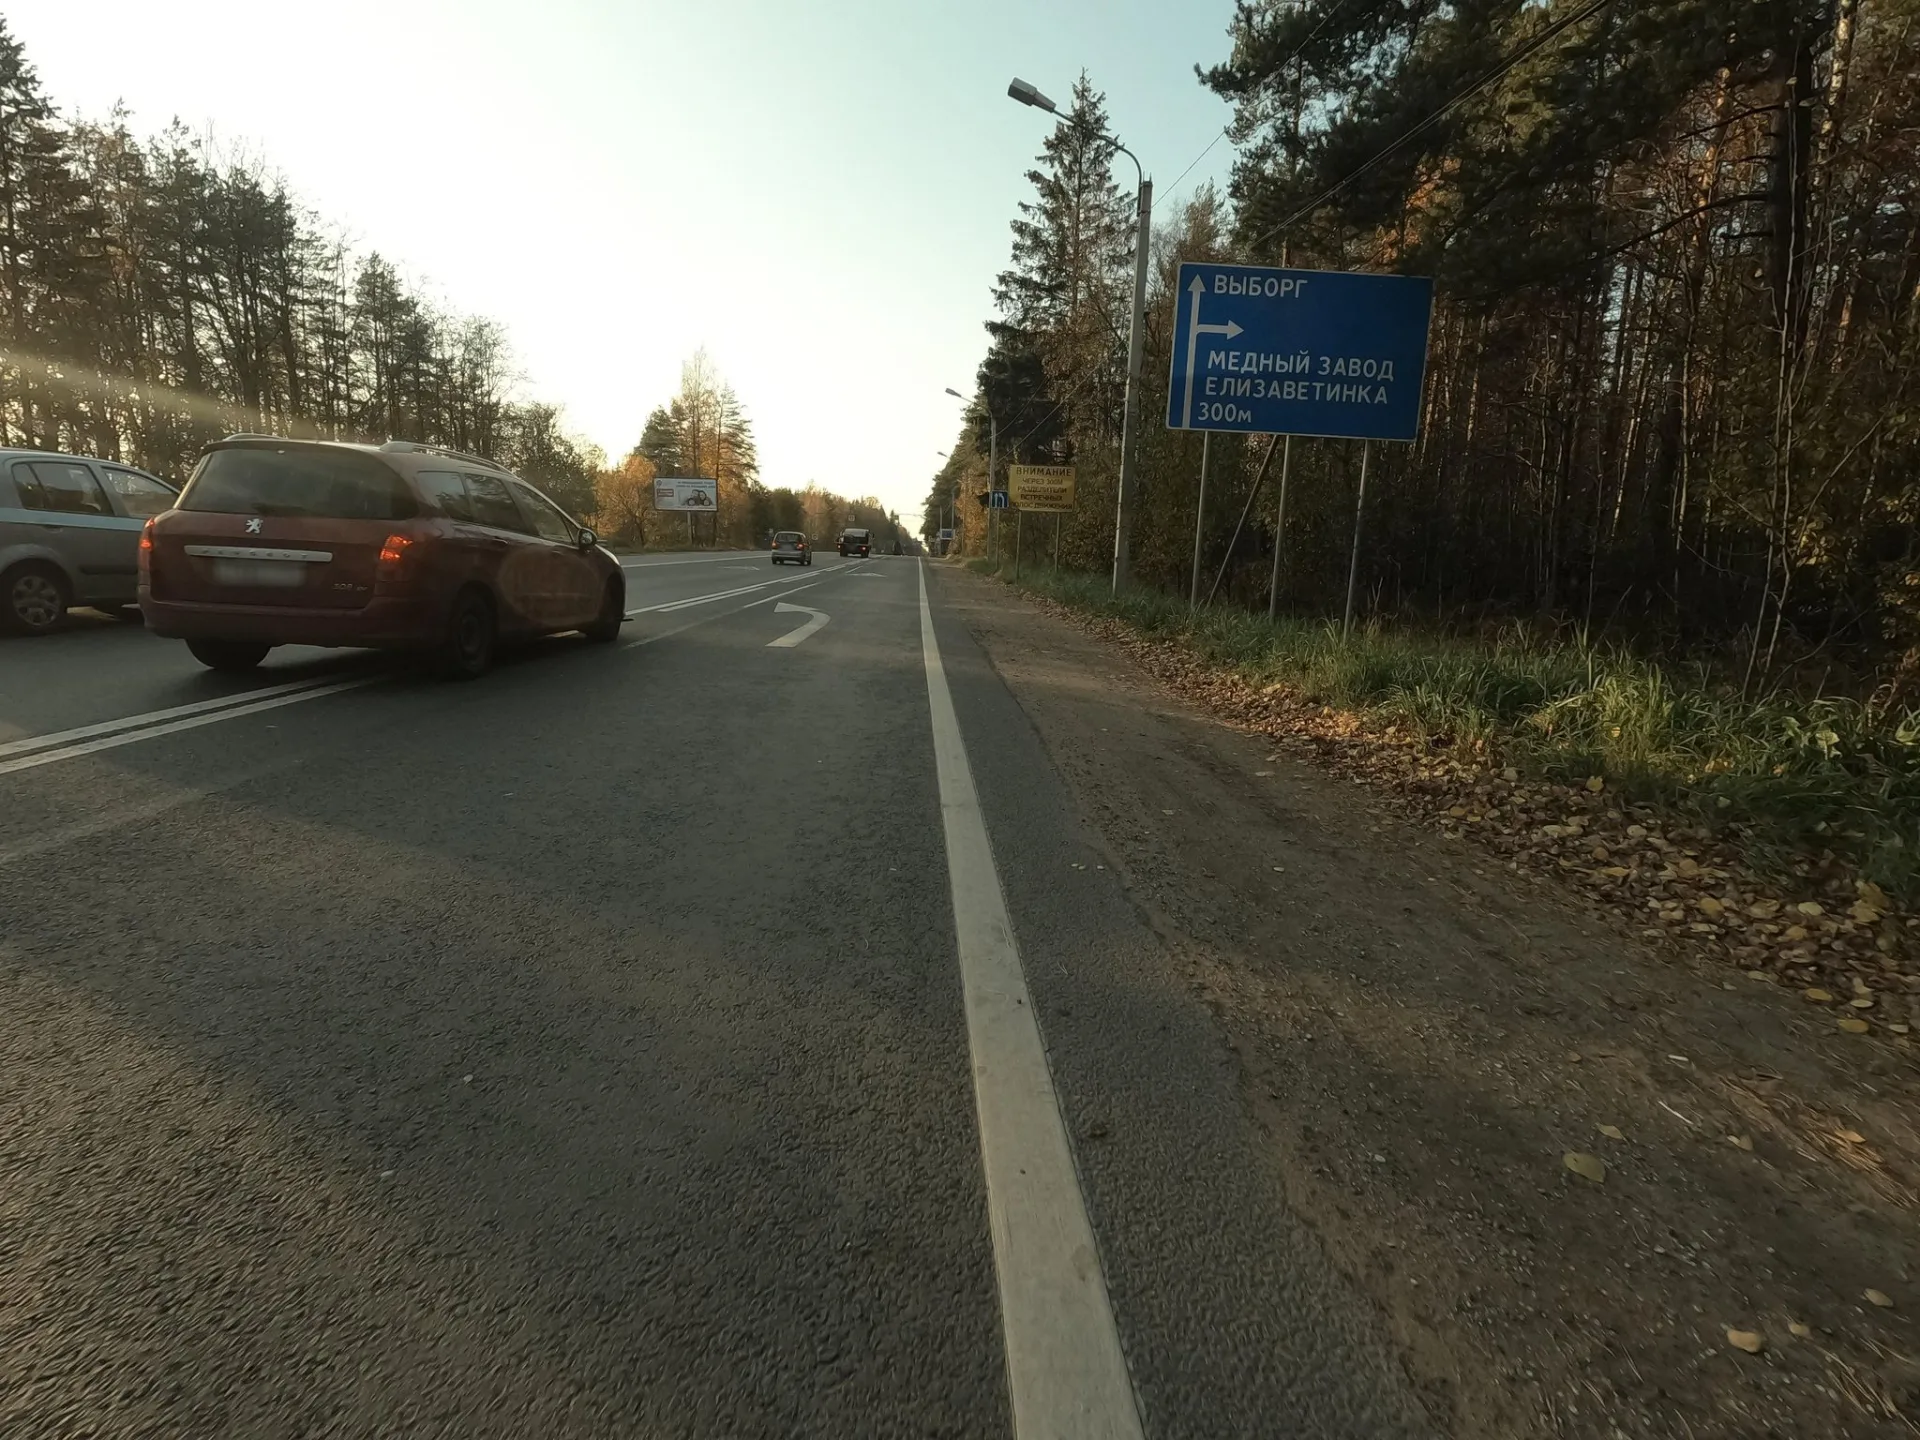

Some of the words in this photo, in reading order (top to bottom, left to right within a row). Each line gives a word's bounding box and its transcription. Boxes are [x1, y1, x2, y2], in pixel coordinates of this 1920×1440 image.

[1214, 274, 1308, 298] ВЫБОРГ
[1207, 350, 1310, 374] МЕДНЫЙ
[1317, 356, 1394, 382] ЗАВОД
[1205, 376, 1388, 404] ЕЛИЗАВЕТИНКА
[1197, 402, 1252, 424] 300м
[1016, 466, 1072, 476] ВНИМАНИЕ
